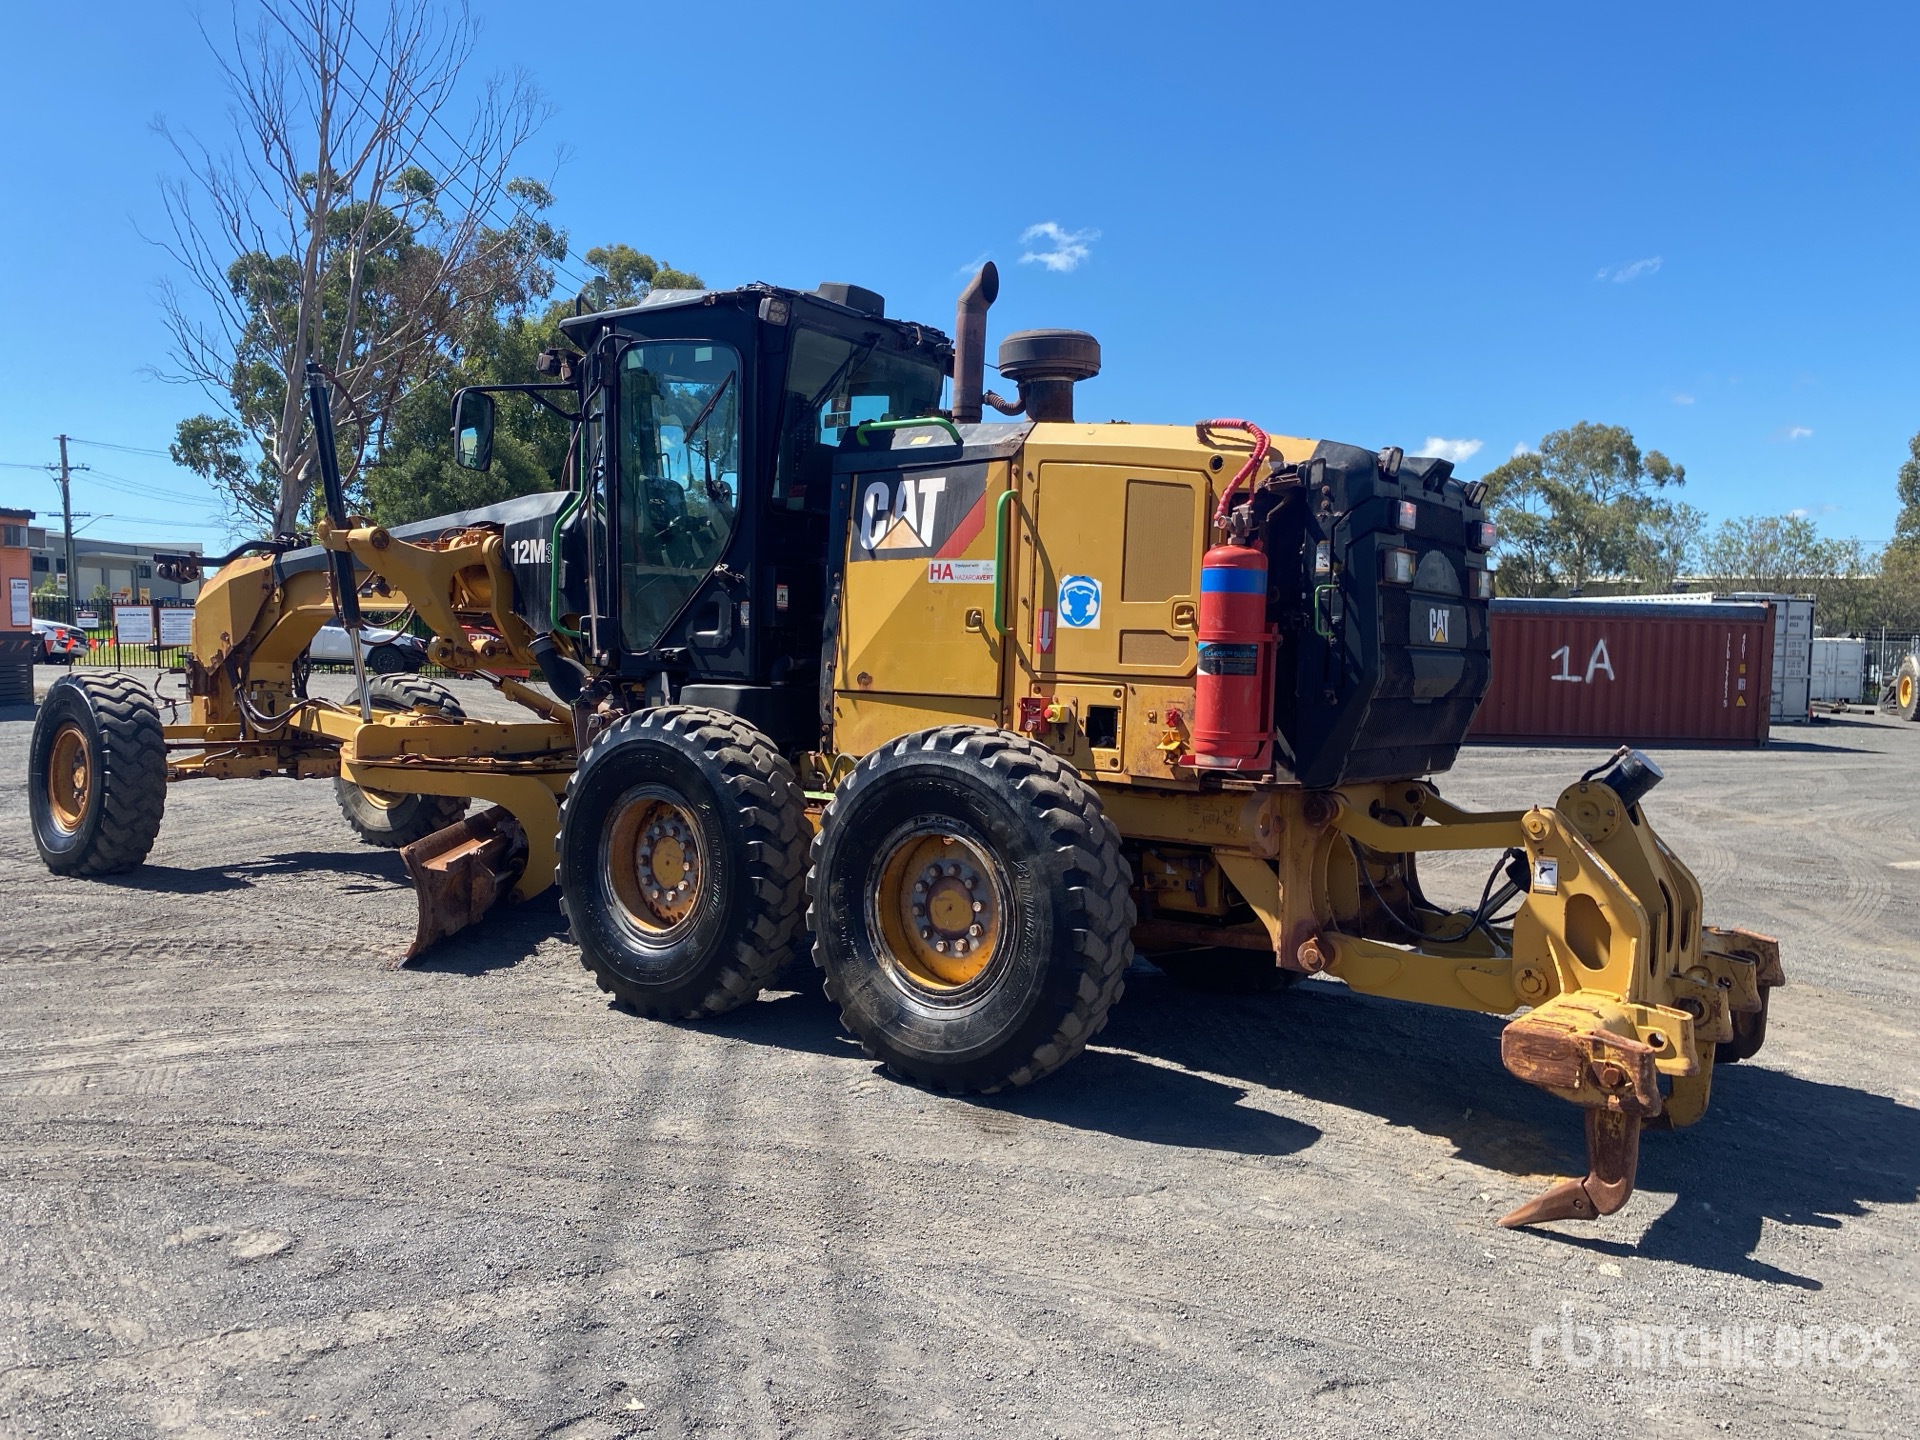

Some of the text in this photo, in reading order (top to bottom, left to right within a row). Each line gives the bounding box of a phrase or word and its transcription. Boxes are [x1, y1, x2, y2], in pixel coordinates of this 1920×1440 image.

[861, 477, 946, 550] CAT
[930, 563, 954, 580] HA
[1429, 607, 1450, 643] CAT
[1551, 639, 1615, 683] 1A
